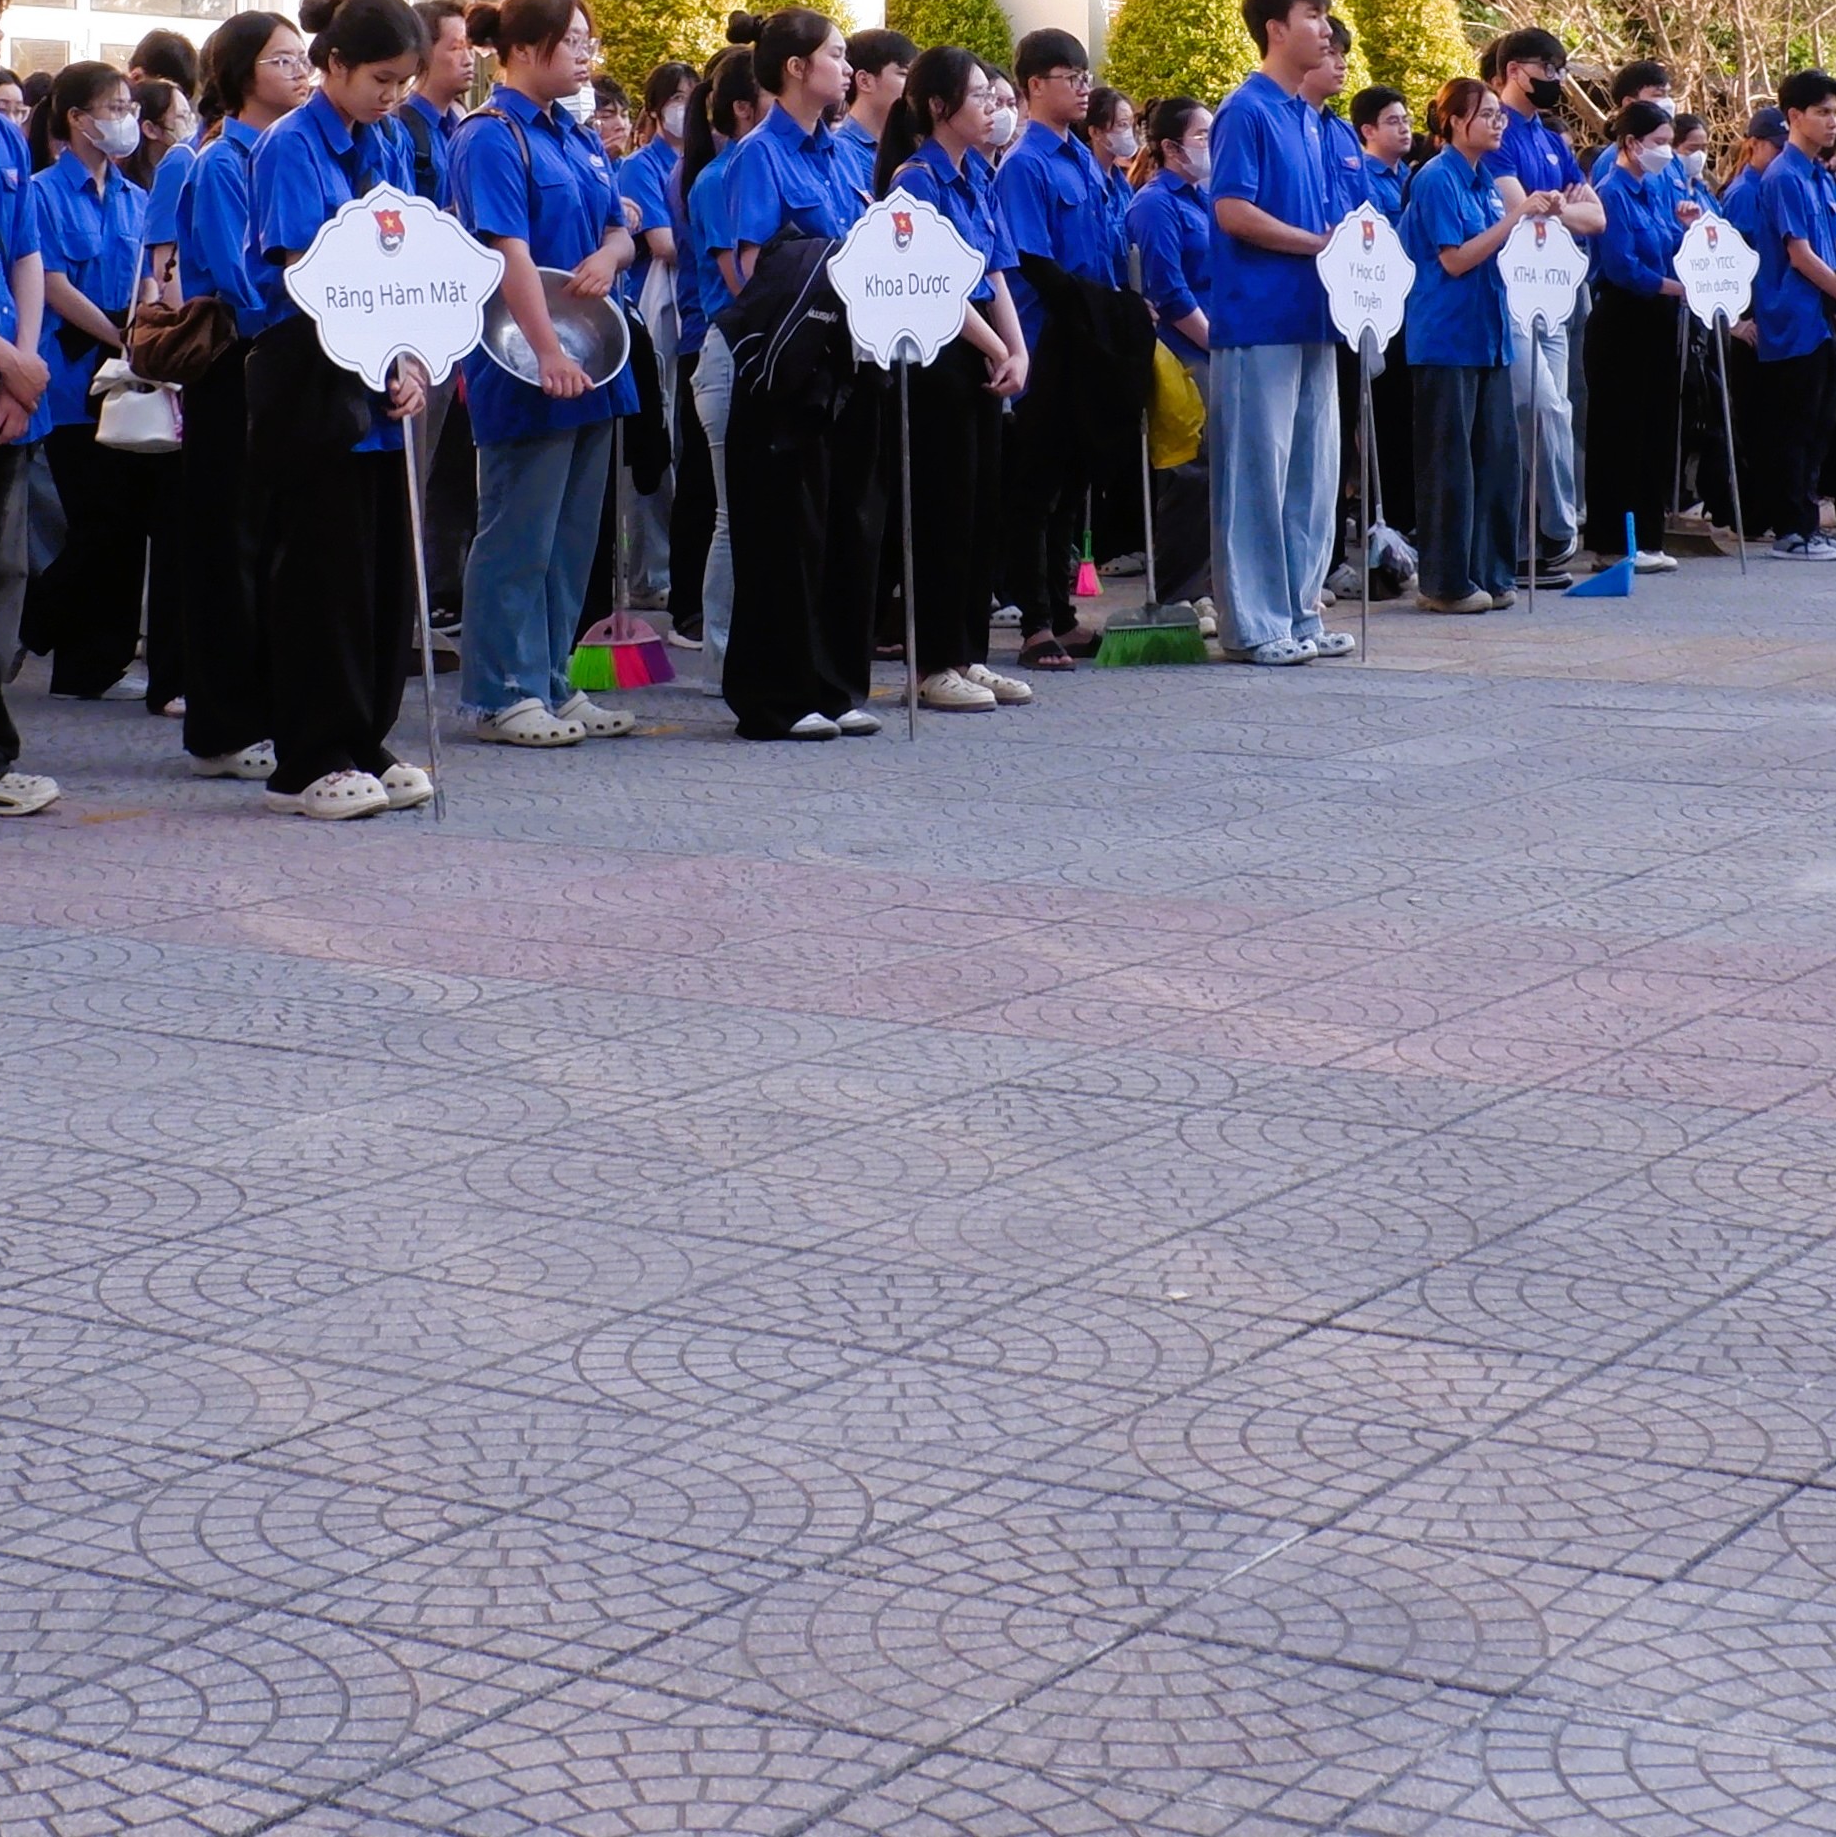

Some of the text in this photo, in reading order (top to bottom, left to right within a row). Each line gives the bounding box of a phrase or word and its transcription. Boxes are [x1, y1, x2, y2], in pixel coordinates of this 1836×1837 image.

[1348, 261, 1356, 278] Y
[1356, 262, 1373, 283] Học
[1513, 266, 1537, 283] KTHA
[1544, 268, 1571, 286] KTXN
[325, 278, 468, 314] Răng Hàm Mặt
[864, 272, 951, 299] Khoa Dược
